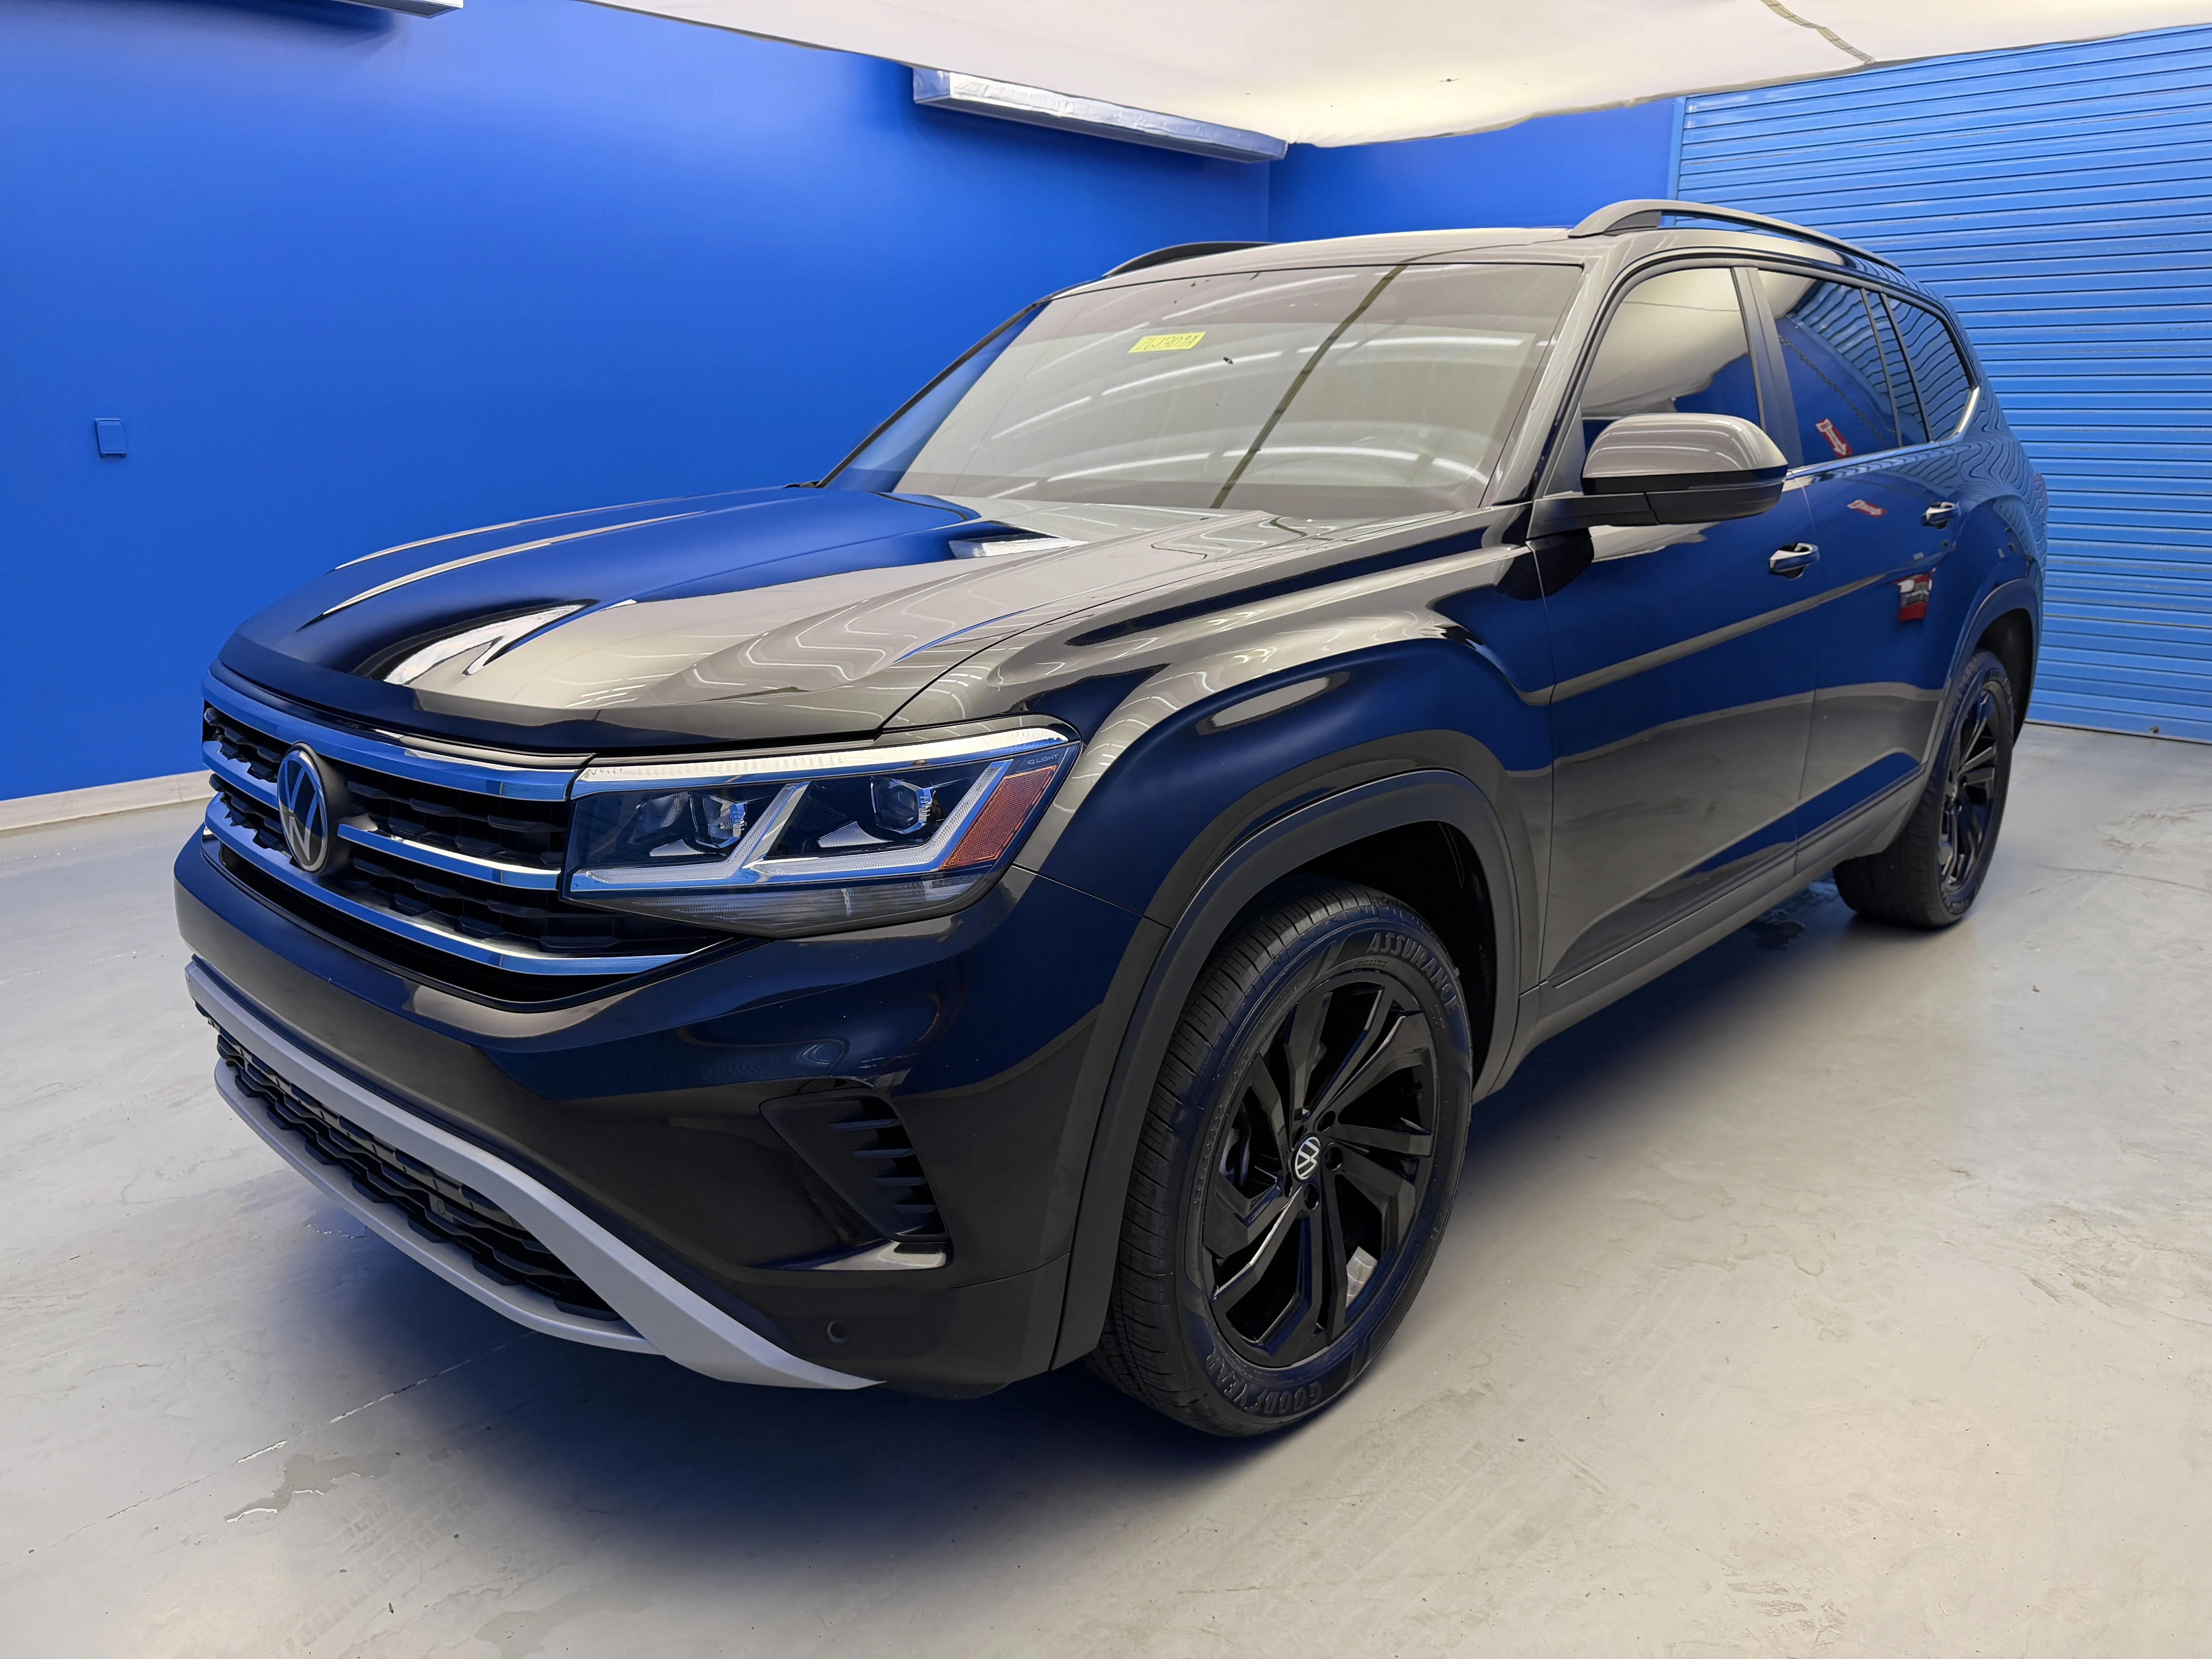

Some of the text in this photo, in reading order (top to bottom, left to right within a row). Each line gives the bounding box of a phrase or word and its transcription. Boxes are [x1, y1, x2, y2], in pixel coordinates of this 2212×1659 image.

[1027, 754, 1058, 764] IQ.LIGHT
[1365, 932, 1461, 1010] ASSURANCE
[1205, 1348, 1322, 1414] GOODYEAR
